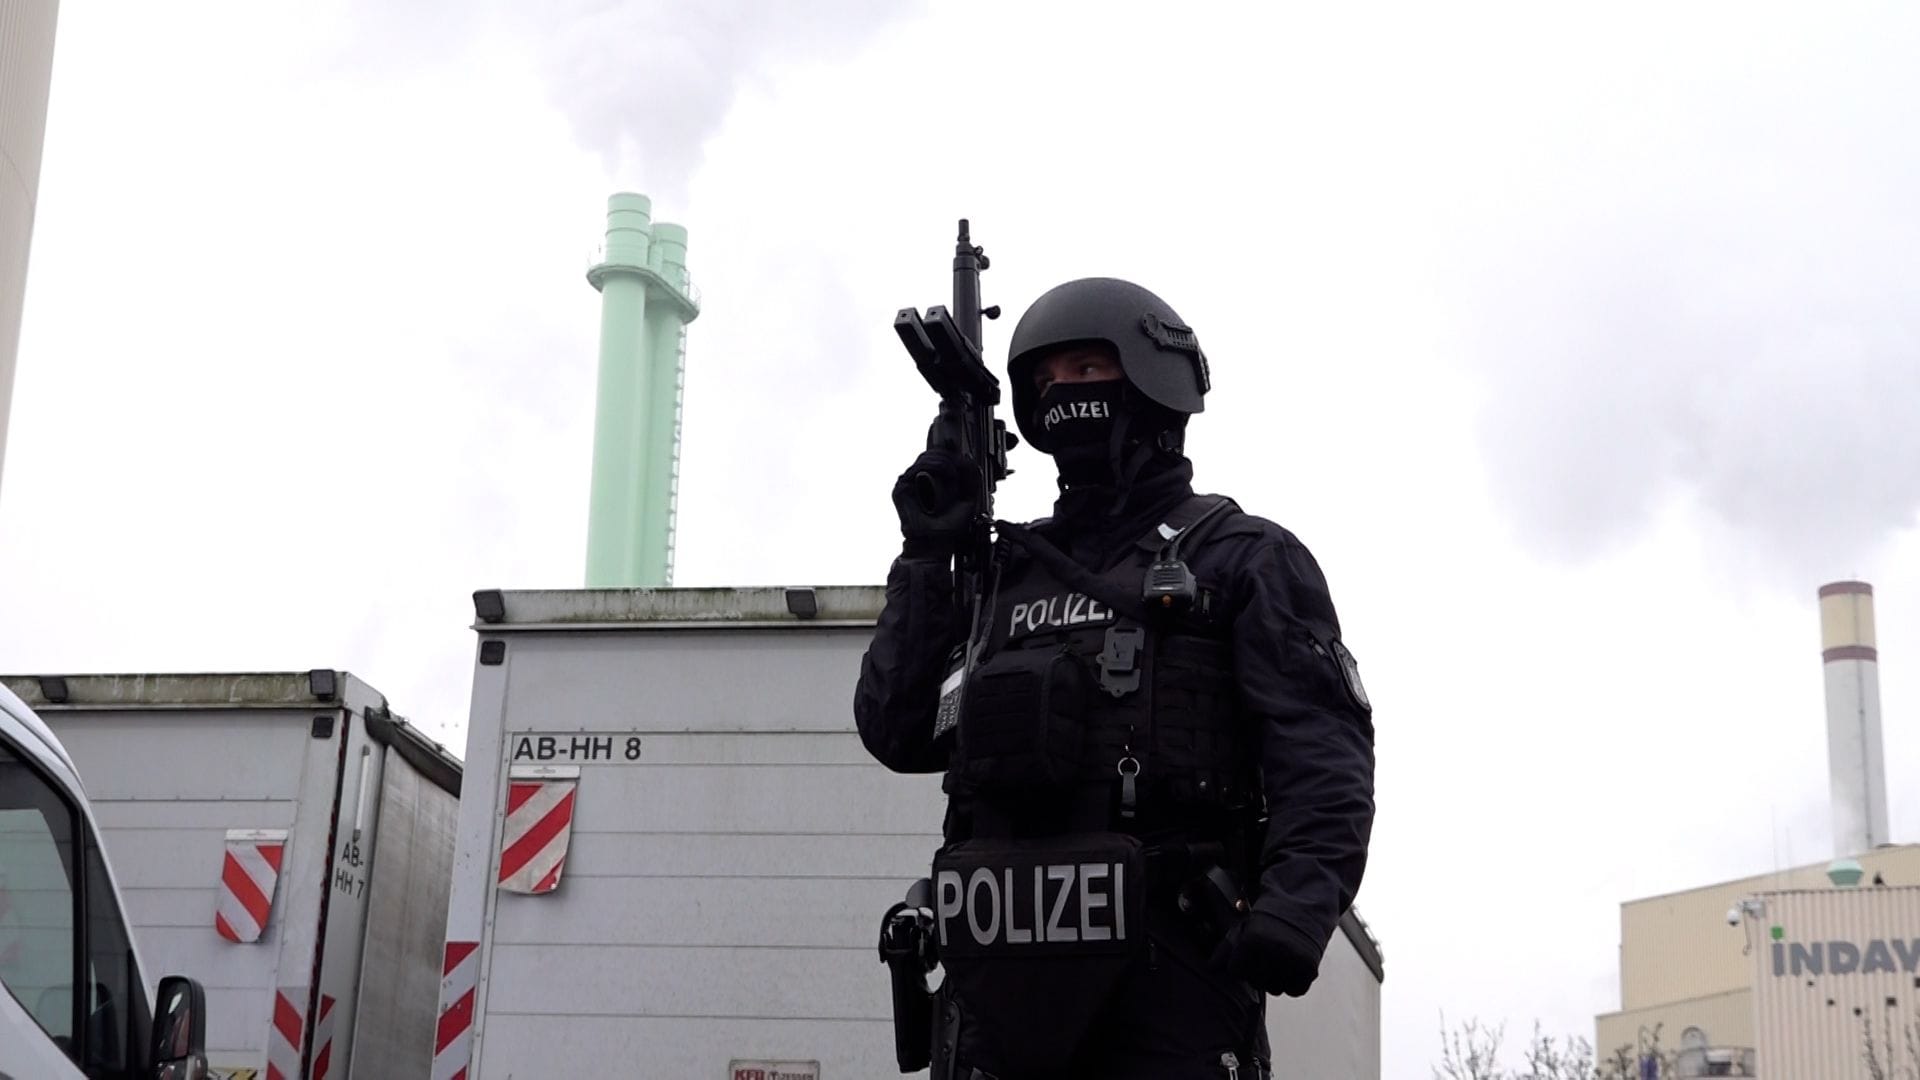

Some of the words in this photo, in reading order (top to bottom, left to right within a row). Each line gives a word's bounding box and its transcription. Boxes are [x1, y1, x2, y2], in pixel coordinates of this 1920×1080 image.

[1044, 401, 1109, 431] POLIZEI
[514, 737, 612, 760] AB-HH
[625, 737, 641, 760] 8
[335, 867, 353, 895] HH
[357, 879, 364, 900] 7
[937, 863, 1126, 946] POLIZEI
